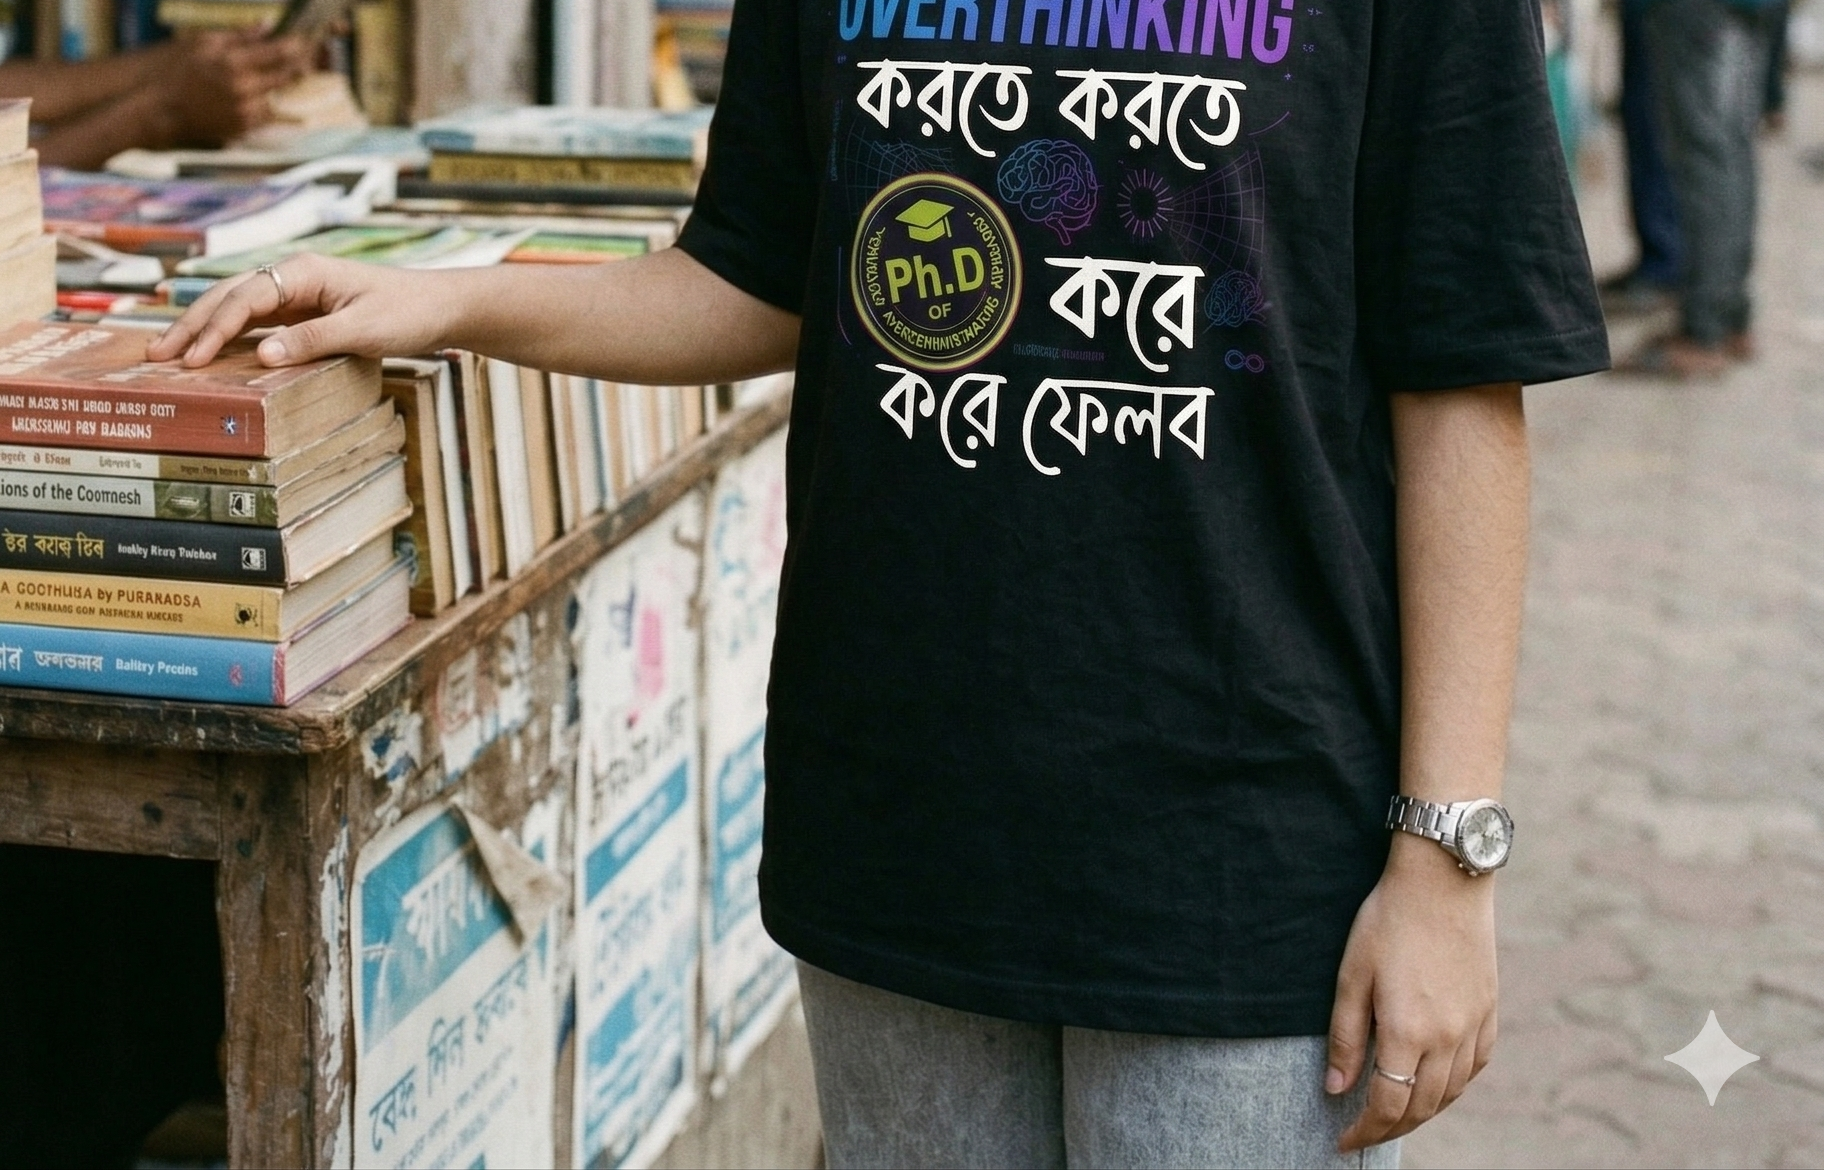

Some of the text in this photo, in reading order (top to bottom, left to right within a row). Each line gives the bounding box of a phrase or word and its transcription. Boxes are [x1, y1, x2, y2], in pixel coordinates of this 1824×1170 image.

[856, 58, 1033, 157] করতে
[1055, 67, 1247, 170] করতে
[885, 246, 985, 304] Ph.D
[928, 302, 952, 320] OF
[1043, 255, 1206, 373] করে
[875, 363, 1216, 476] করে ফেলব
[33, 481, 47, 499] of
[51, 482, 73, 501] the
